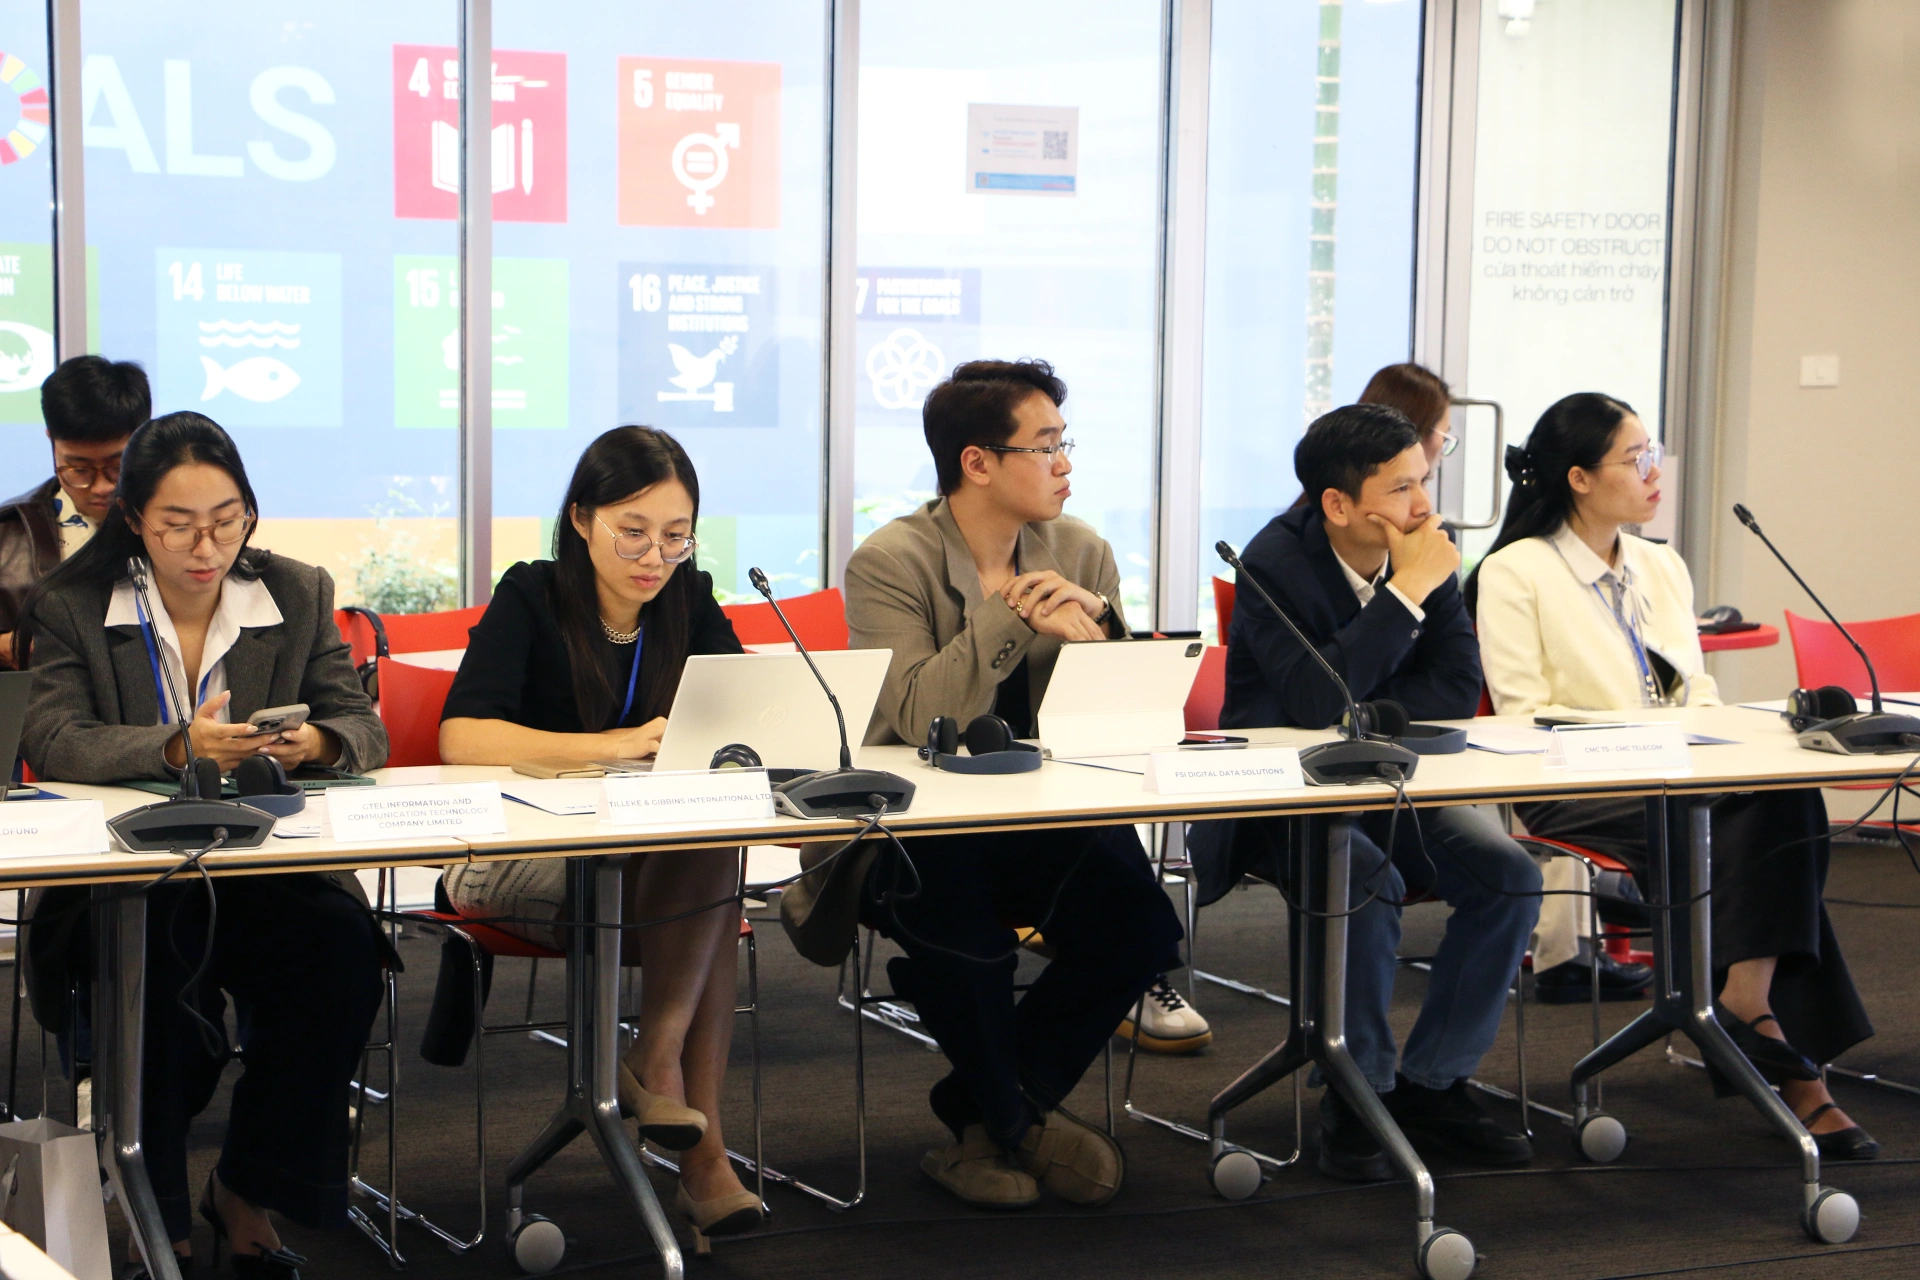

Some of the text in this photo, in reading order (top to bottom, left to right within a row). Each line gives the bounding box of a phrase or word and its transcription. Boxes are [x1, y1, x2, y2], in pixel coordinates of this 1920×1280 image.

[408, 58, 431, 97] 4
[634, 69, 653, 108] 5
[1485, 211, 1661, 230] FIRE SAFETY DOOR
[1483, 236, 1663, 255] DO NOT OBSTRUCT
[168, 261, 205, 301] 14
[216, 263, 244, 281] LIFE
[216, 284, 311, 304] BELOW WATER
[405, 269, 440, 308] 15
[629, 274, 661, 312] 16
[1188, 770, 1217, 778] DIGITAL
[1219, 769, 1240, 777] DATA
[1241, 768, 1284, 776] SOLUTIONS
[362, 797, 472, 810] GTEL INFORMATION AND
[608, 800, 642, 808] TILLEKE
[652, 797, 686, 806] GIBBINS
[688, 794, 754, 804] INTERNATIONAL
[756, 792, 772, 801] LTD
[347, 806, 489, 821] COMMUNICATION TECHNOLOGY
[379, 818, 462, 829] COMPANY LIMITED
